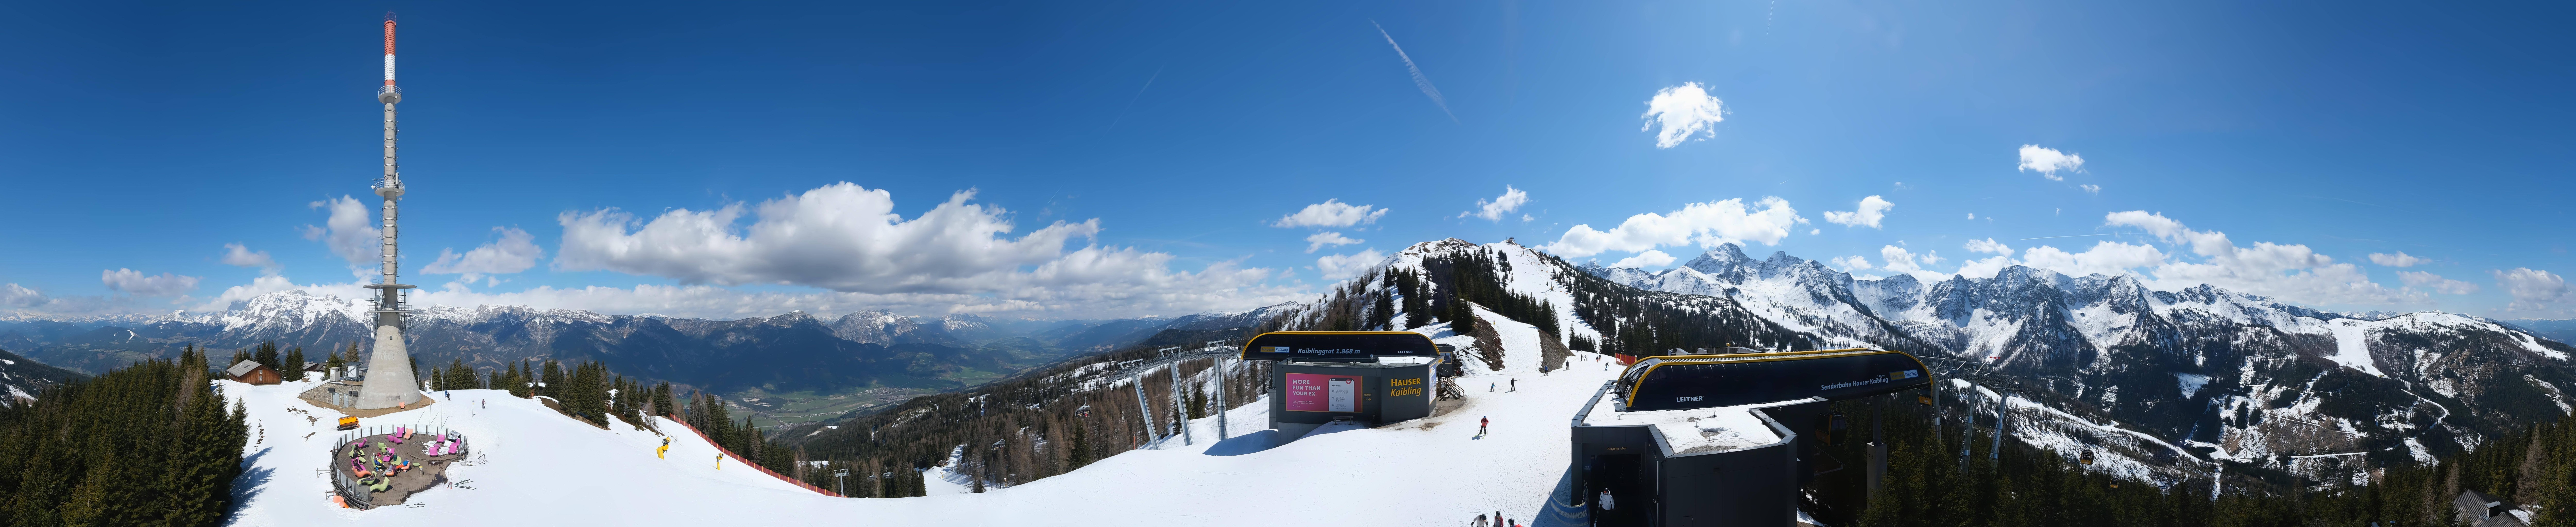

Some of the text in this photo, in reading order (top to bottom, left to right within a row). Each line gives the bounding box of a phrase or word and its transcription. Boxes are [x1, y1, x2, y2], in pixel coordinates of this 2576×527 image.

[1391, 378, 1421, 387] HAUSER
[1821, 382, 1852, 390] Senderbahn
[1391, 387, 1421, 397] Kaibling
